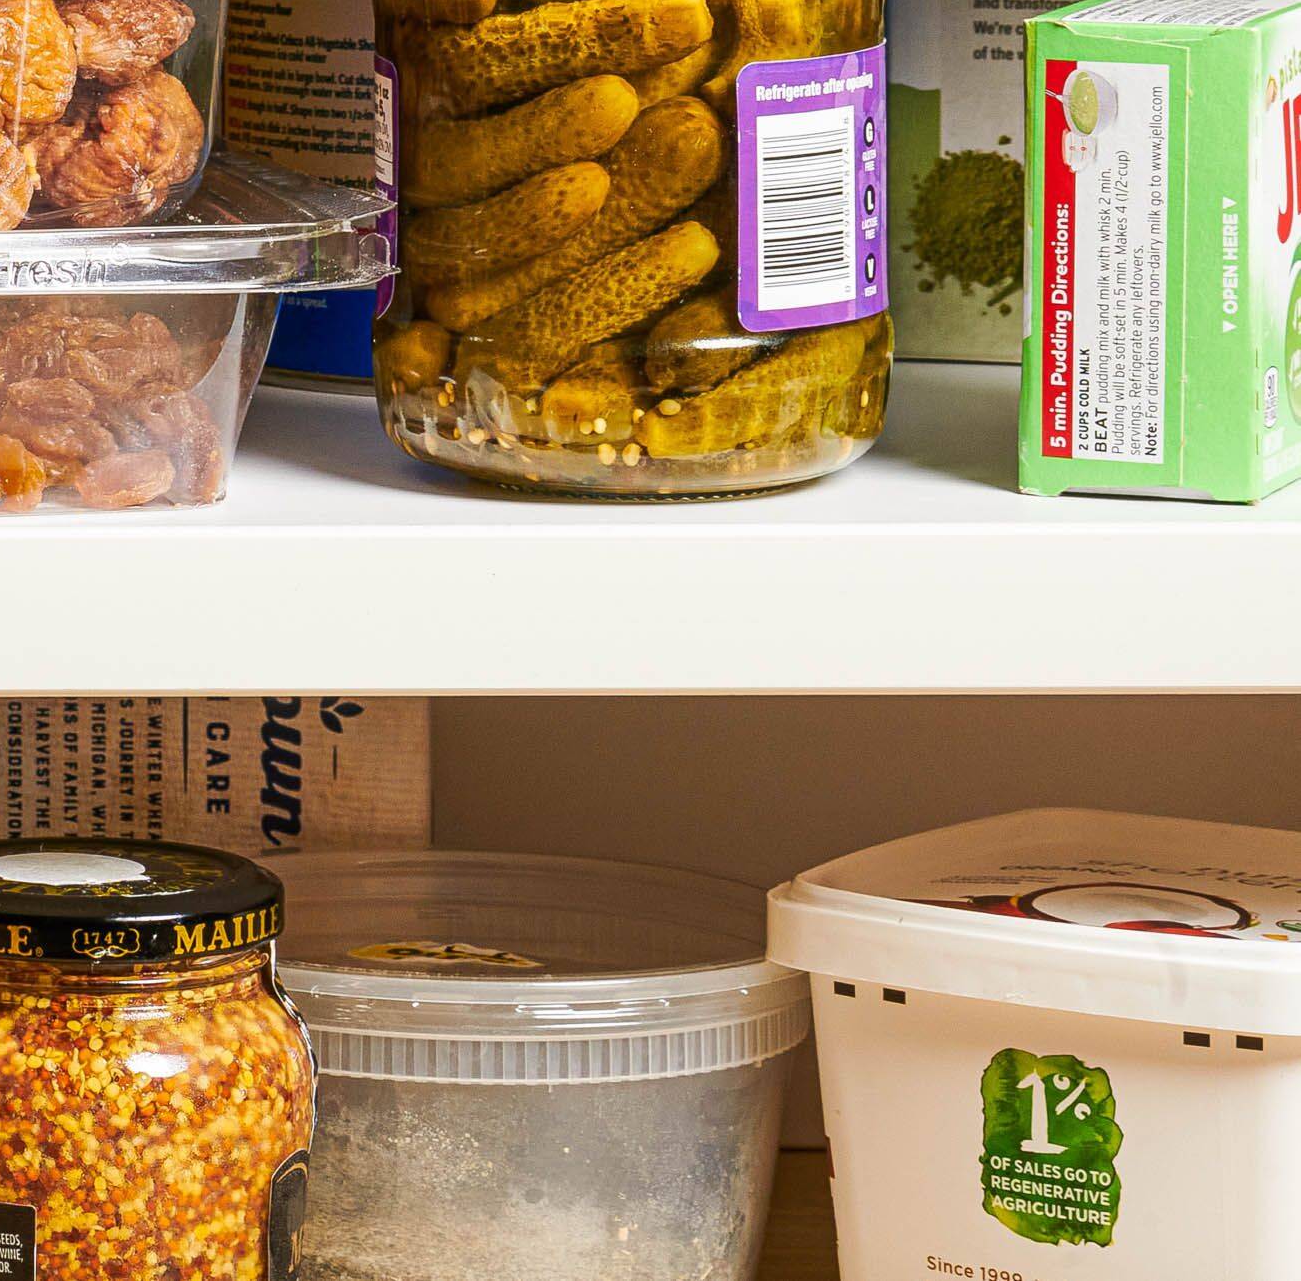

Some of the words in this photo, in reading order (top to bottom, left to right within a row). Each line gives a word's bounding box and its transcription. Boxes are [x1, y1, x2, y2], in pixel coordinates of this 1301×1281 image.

[756, 81, 822, 102] Refrigerate
[823, 78, 845, 94] after
[1149, 86, 1164, 176] www.jello.com
[1050, 204, 1068, 304] Directions:
[1223, 213, 1238, 260] HERE
[1223, 266, 1238, 314] OPEN
[1050, 310, 1072, 386] Pudding
[1079, 348, 1090, 375] MILK
[1050, 391, 1066, 431] min.
[1079, 378, 1090, 408] COLD
[1050, 436, 1066, 449] 5
[1079, 411, 1089, 439] CUPS
[1095, 407, 1108, 452] BEAT
[1145, 423, 1157, 456] Note:
[35, 707, 51, 789] HARVEST
[146, 715, 162, 783] WINTER
[205, 721, 230, 815] CARE
[62, 763, 79, 825] FAMILY
[1016, 1068, 1092, 1154] 1%
[990, 1155, 1011, 1171] OF
[1014, 1159, 1061, 1180] SALES
[1064, 1167, 1088, 1182] GO
[1090, 1170, 1111, 1186] TO
[990, 1175, 1111, 1206] REGENERATIVE
[991, 1195, 1111, 1226] AGRICULTURE
[927, 1256, 975, 1278] Since
